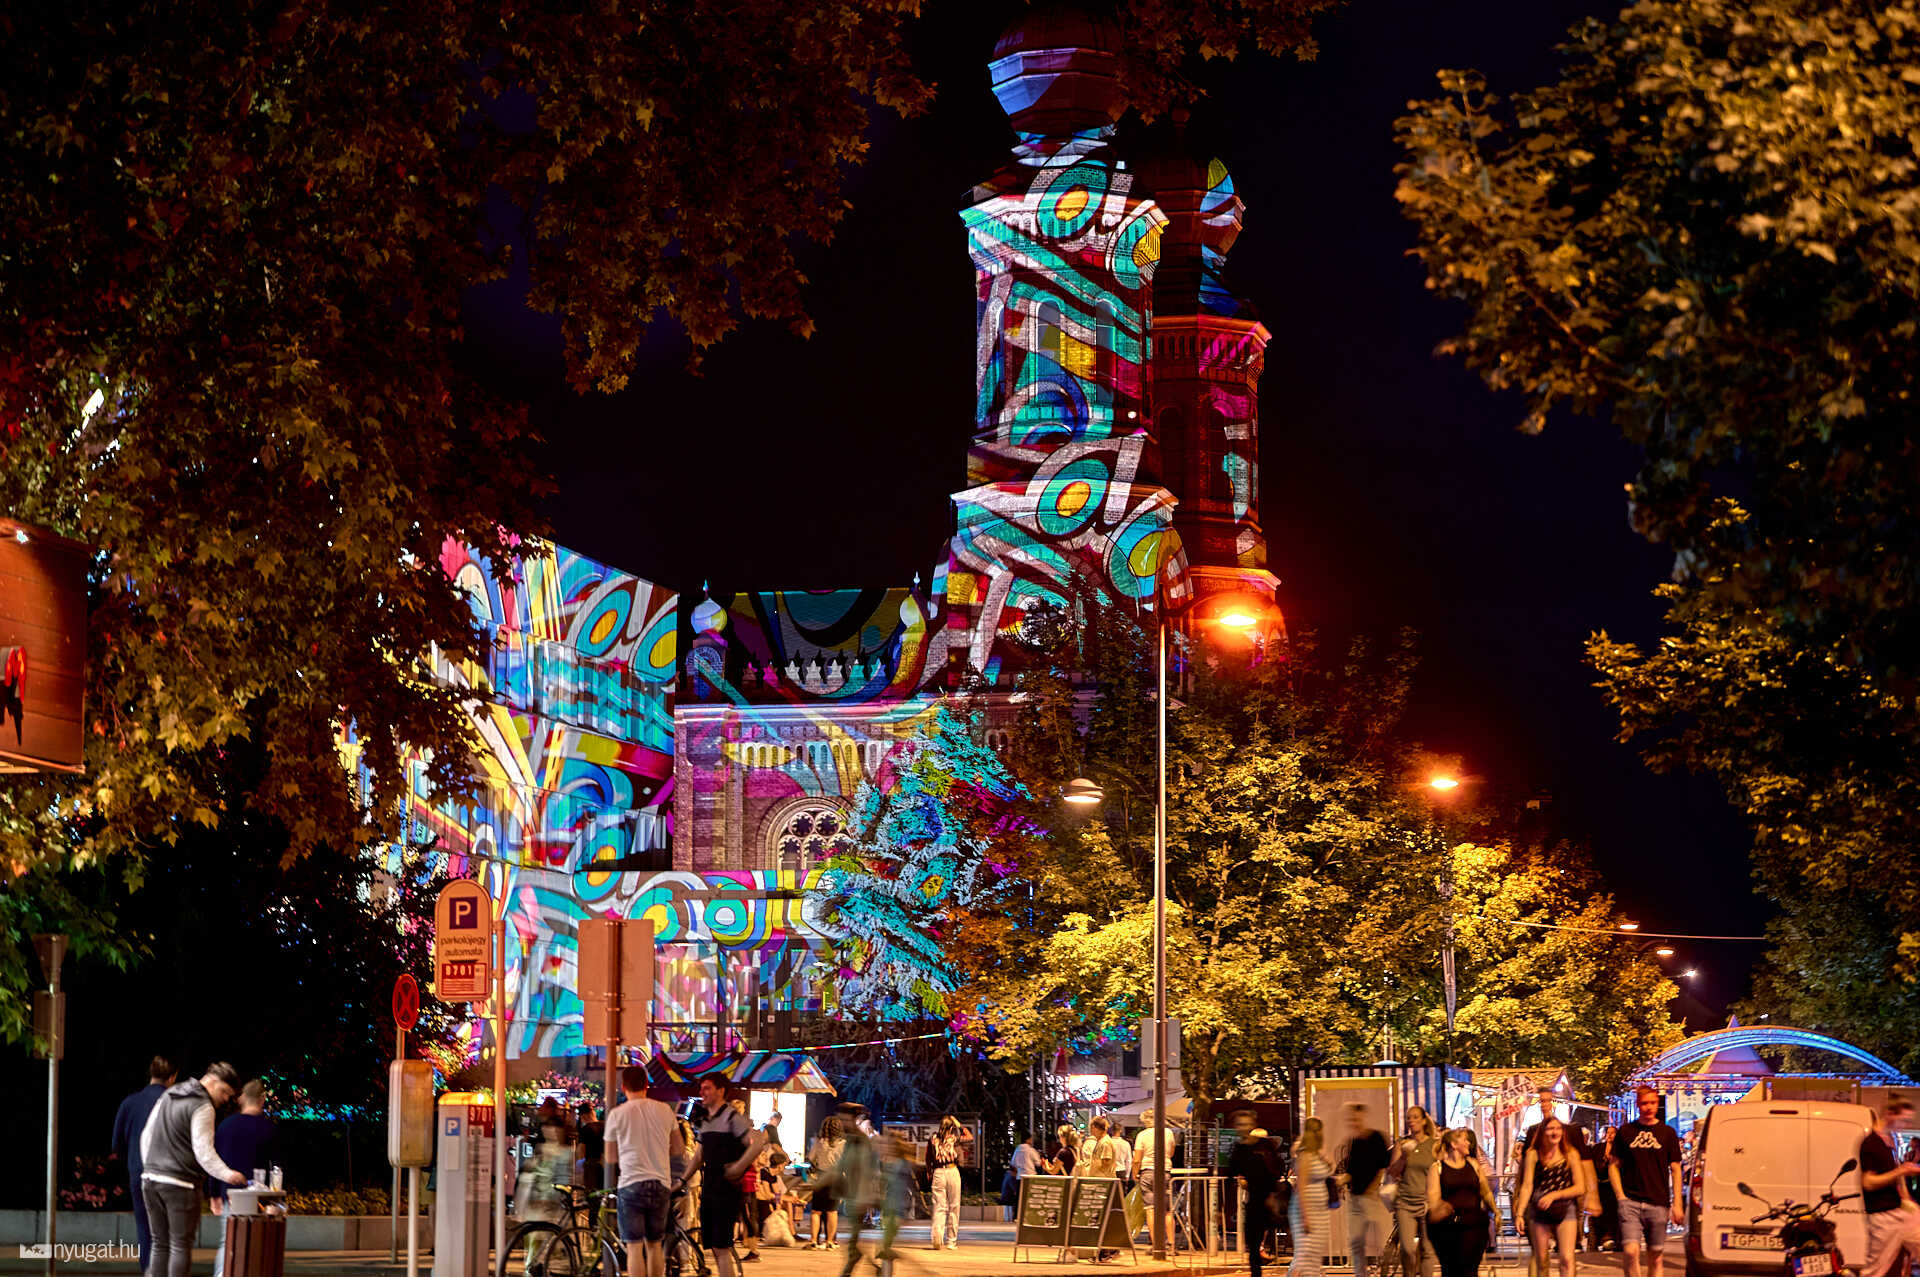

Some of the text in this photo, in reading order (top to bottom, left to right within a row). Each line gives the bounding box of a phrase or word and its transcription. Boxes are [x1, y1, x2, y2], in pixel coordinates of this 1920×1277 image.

[456, 901, 471, 925] P
[470, 1106, 493, 1122] 9701
[447, 1119, 459, 1134] P
